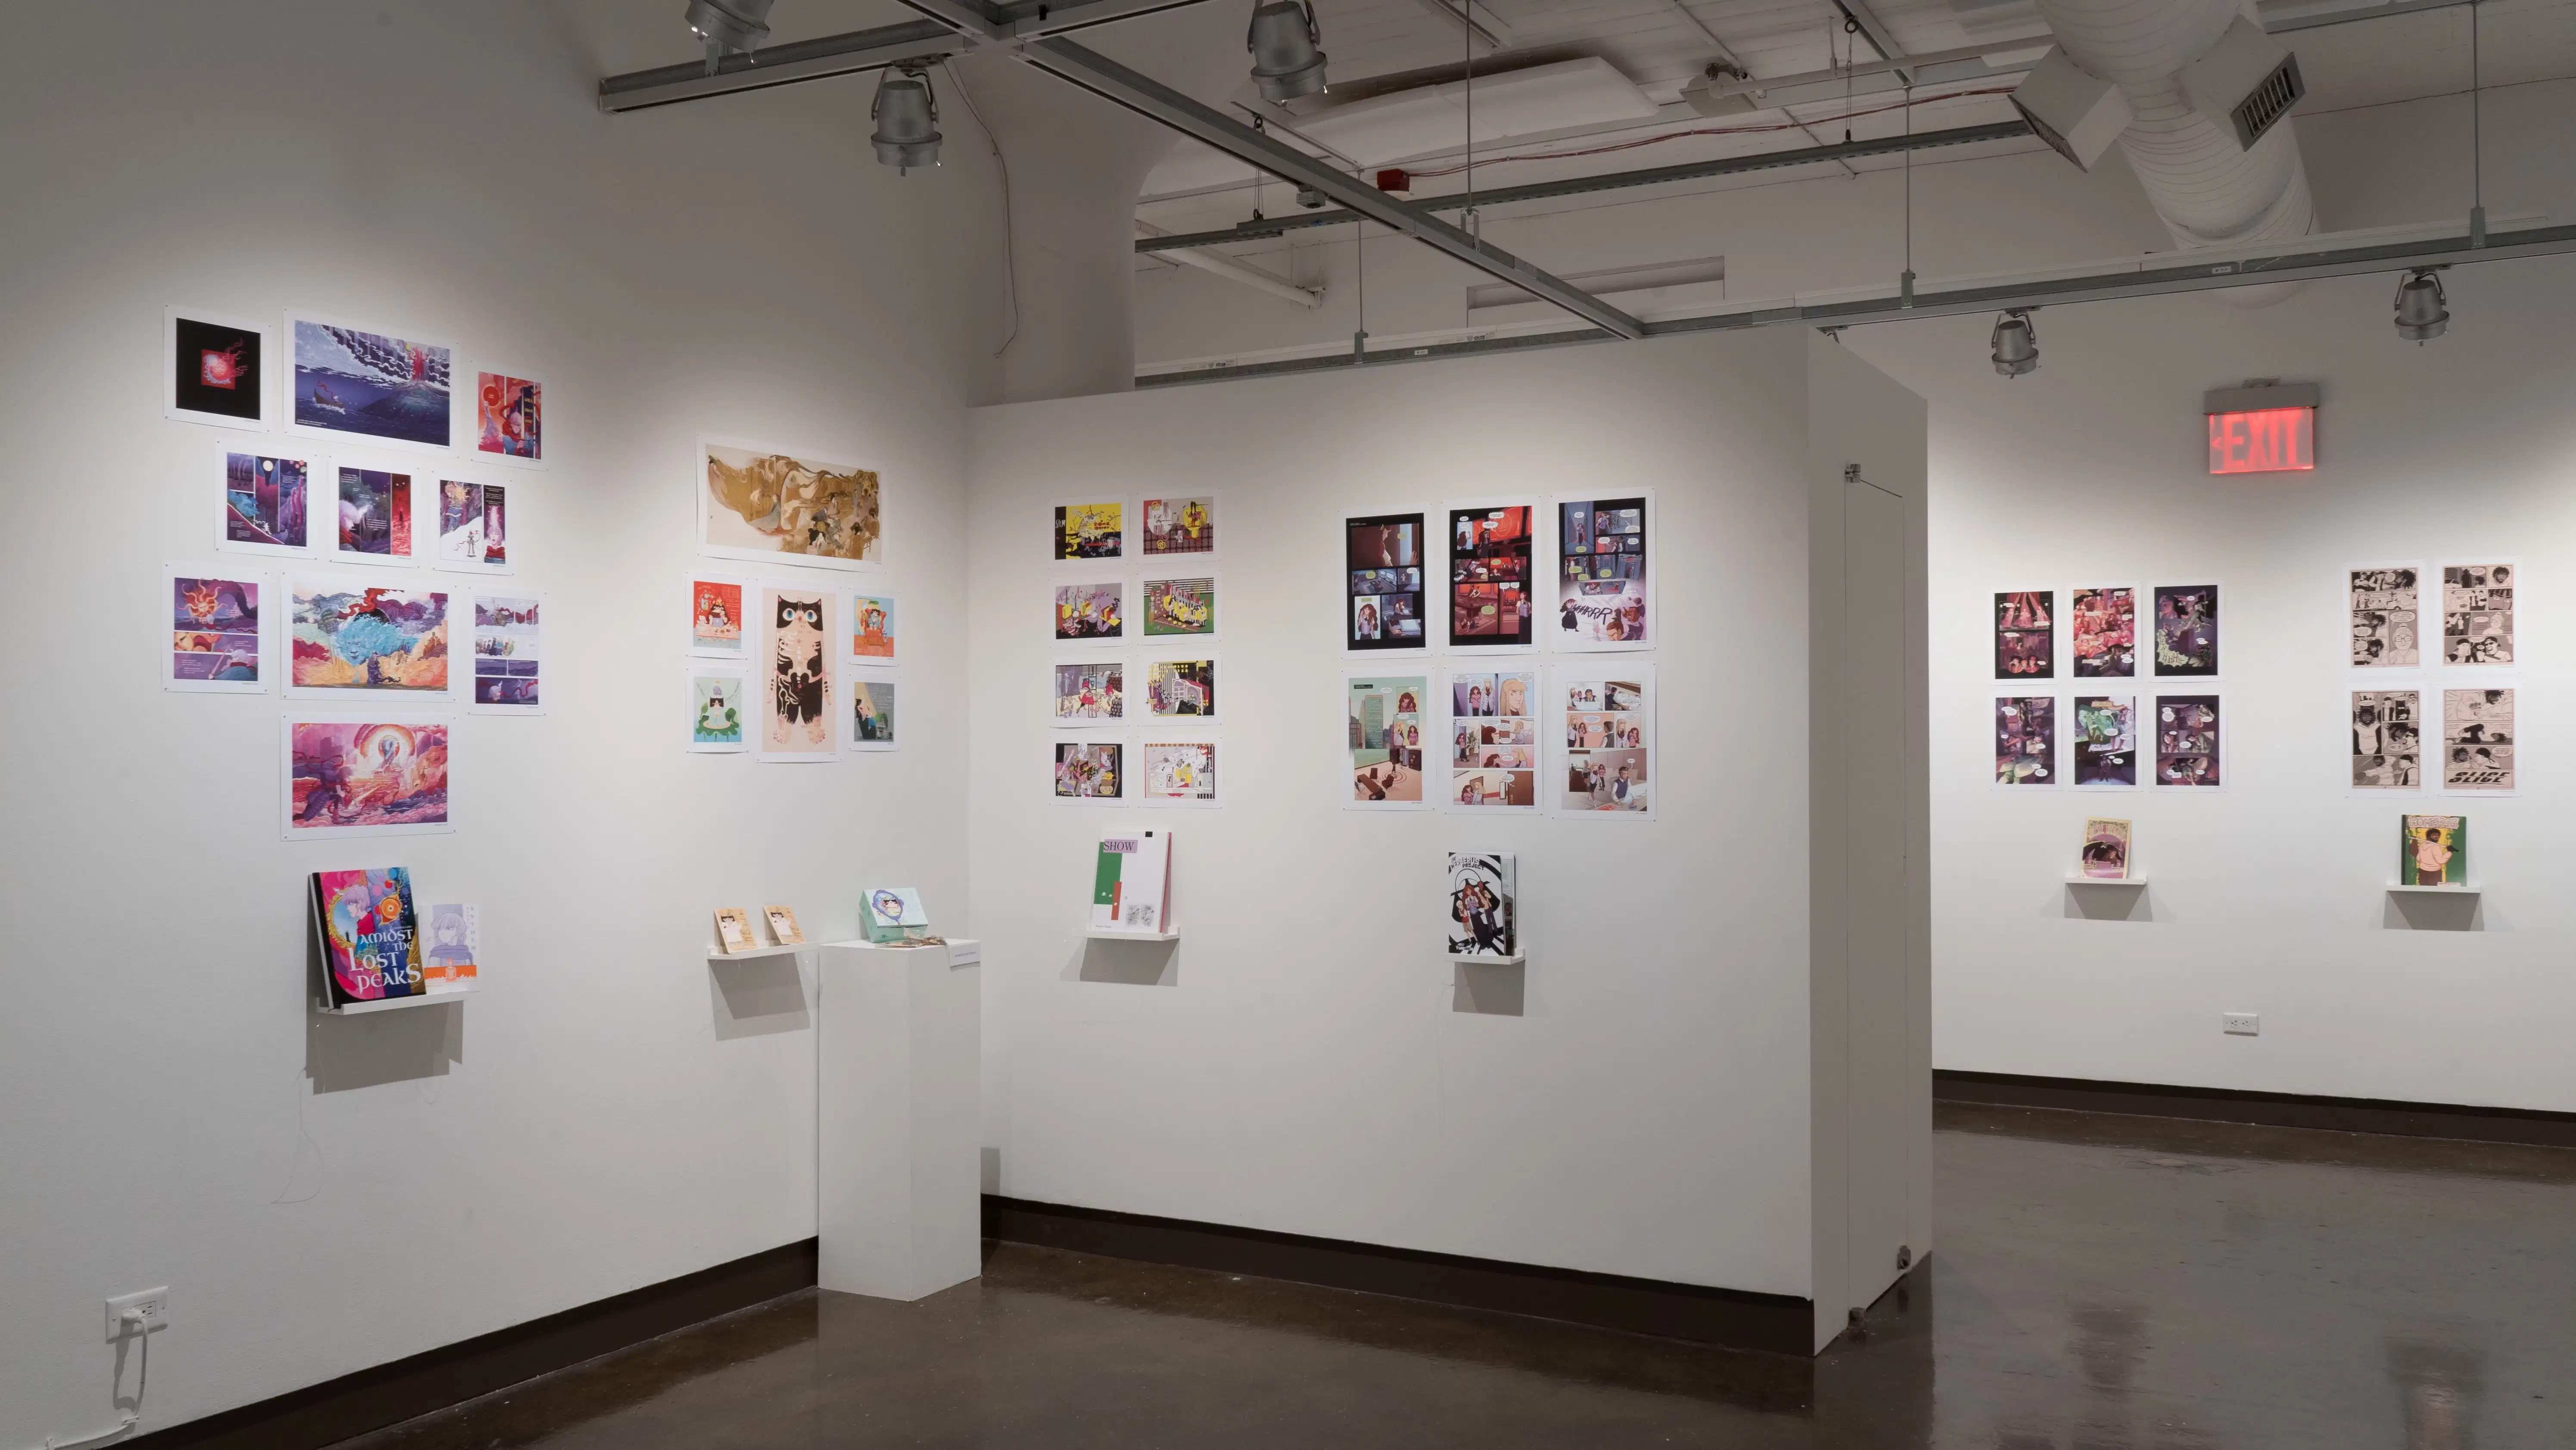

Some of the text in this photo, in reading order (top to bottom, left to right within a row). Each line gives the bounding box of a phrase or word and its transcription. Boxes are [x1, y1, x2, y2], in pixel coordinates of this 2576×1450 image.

[2223, 409, 2302, 469] EXIT
[2409, 817, 2459, 829] HOMELESS
[1103, 841, 1135, 851] SHOW
